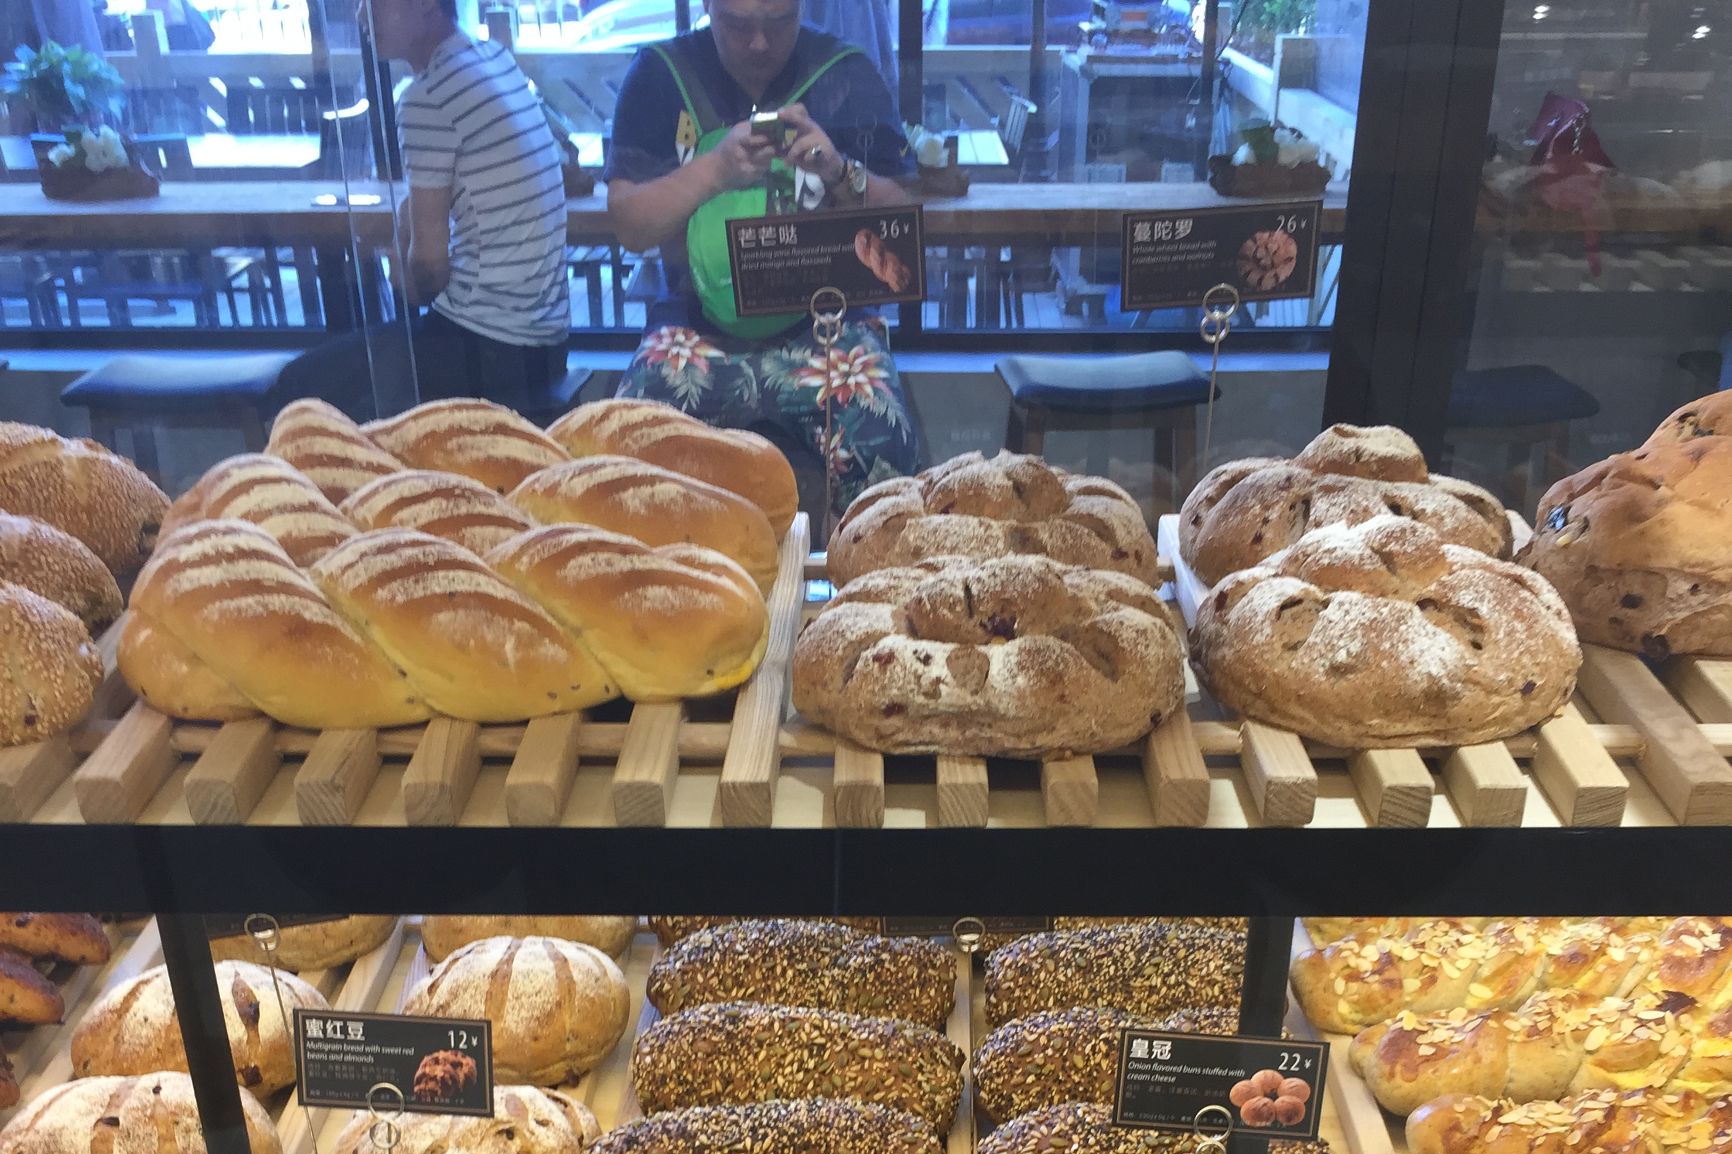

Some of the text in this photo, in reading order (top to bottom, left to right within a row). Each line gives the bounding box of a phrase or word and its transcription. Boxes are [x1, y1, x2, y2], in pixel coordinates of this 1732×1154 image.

[1179, 242, 1200, 251] bread
[1201, 239, 1217, 249] with
[1171, 253, 1186, 262] and
[305, 1018, 365, 1041] 蜜红豆
[306, 1041, 415, 1056] Multigrain bread with sweet red
[1129, 1038, 1172, 1060] 皇冠
[307, 1051, 375, 1064] beans and almonds
[1127, 1060, 1246, 1078] Onion flavored buns stuffed with
[1126, 1073, 1177, 1084] cream cheese
